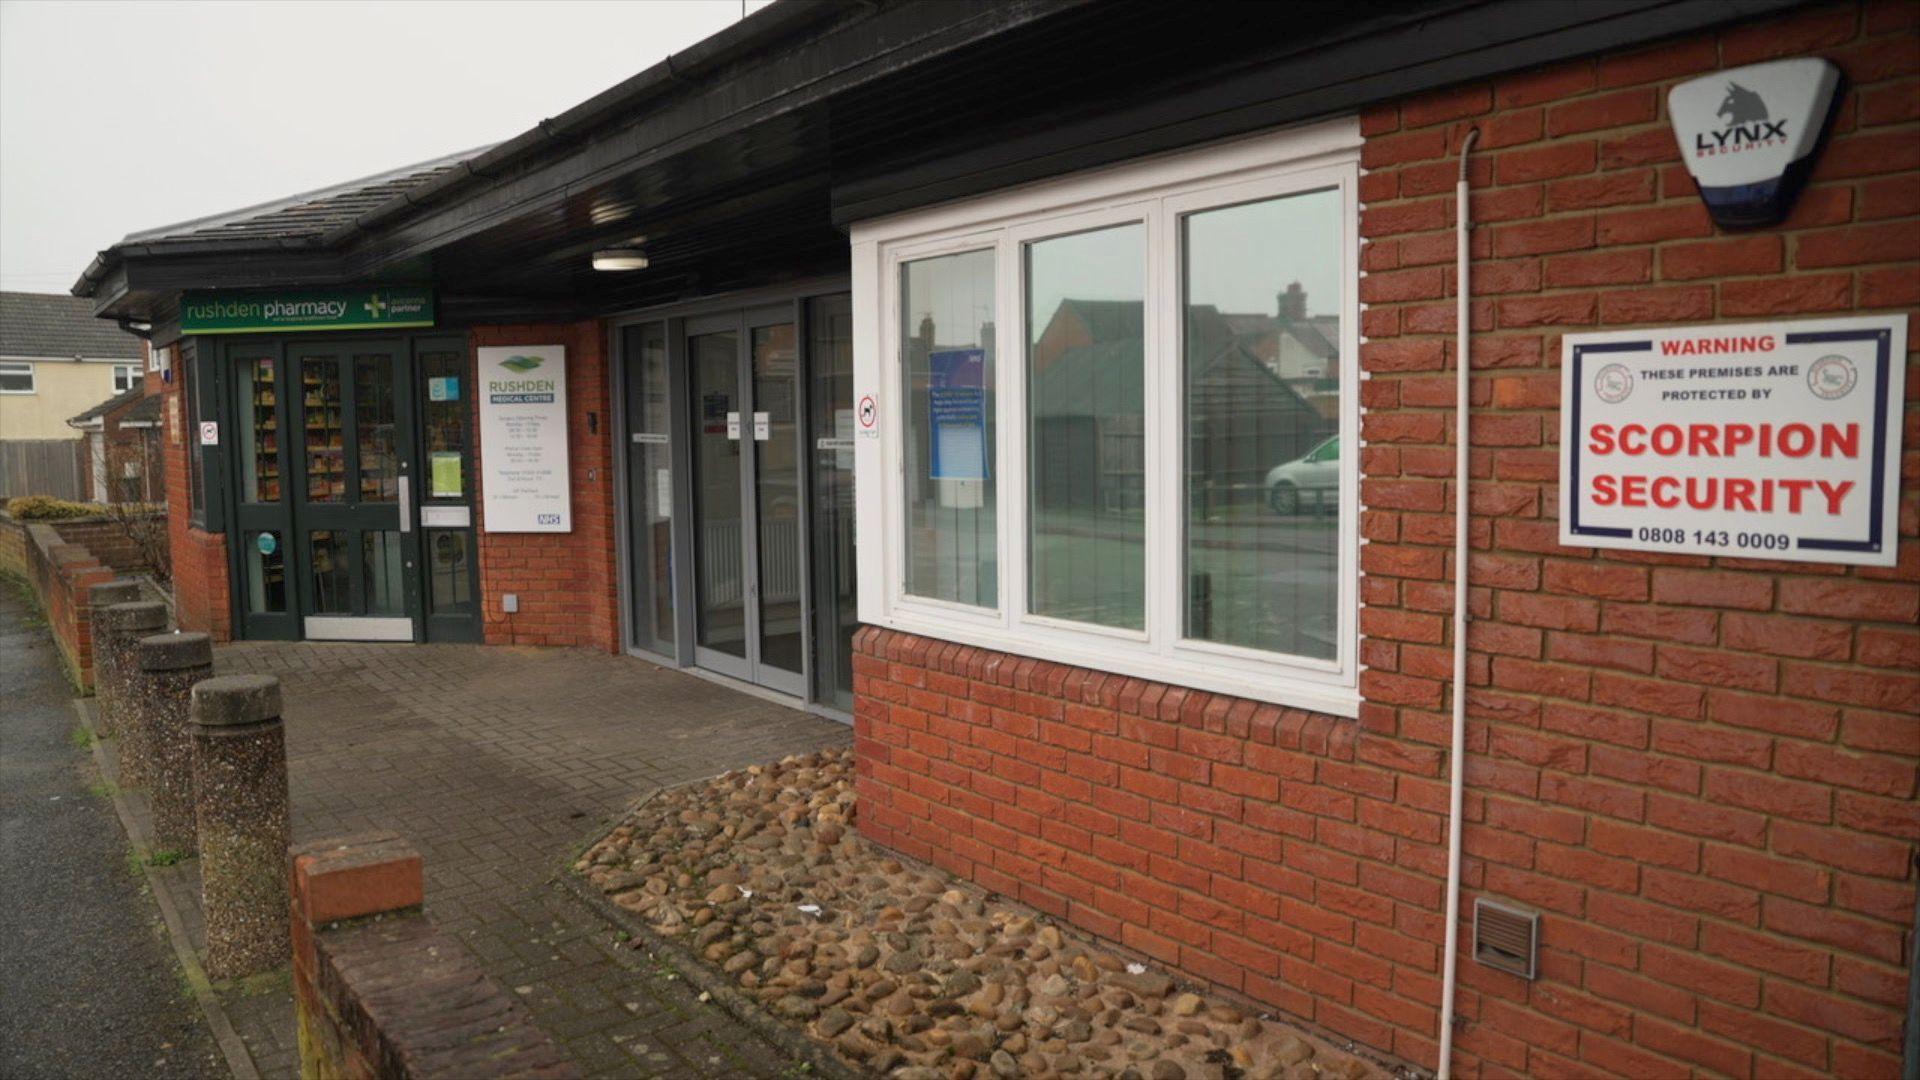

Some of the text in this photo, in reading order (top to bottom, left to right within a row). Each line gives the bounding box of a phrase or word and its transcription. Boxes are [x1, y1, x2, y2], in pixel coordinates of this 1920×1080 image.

[1697, 120, 1787, 151] LYNX
[1697, 138, 1788, 158] SECURITY
[187, 300, 347, 319] rushden pharmacy
[391, 304, 421, 313] partner
[1661, 336, 1777, 356] WARNING
[1641, 365, 1800, 380] THESE PREMISES ARE
[489, 380, 554, 393] RUSHDEN
[1662, 389, 1773, 401] PROTECTED BY
[492, 394, 553, 403] MEDICAL CENTRE
[1588, 422, 1861, 460] SCORPION
[1591, 474, 1856, 516] SECURITY
[538, 514, 560, 524] NHS
[1639, 527, 1790, 551] 0808 143 0009
